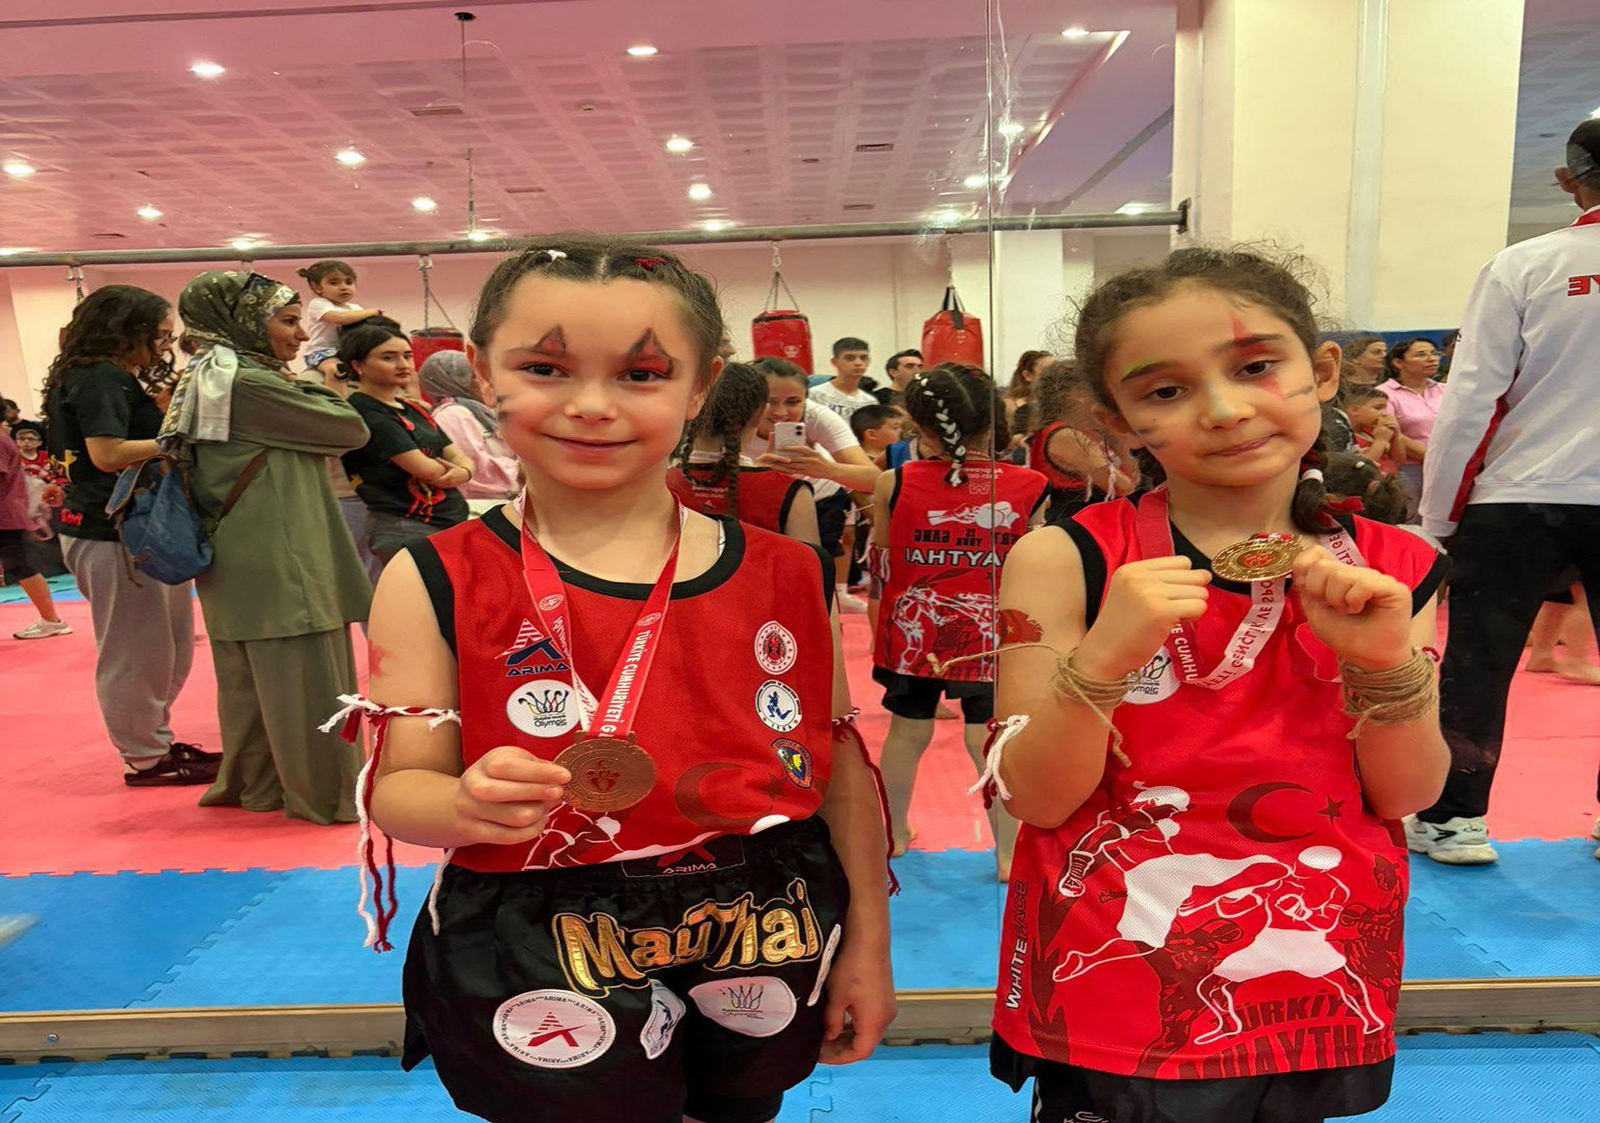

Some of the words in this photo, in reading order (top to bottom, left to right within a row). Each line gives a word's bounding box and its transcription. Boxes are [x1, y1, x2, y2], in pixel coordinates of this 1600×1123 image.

[626, 629, 652, 664] TÜRKİYE
[506, 662, 572, 677] ARIMA
[1174, 637, 1199, 682] CUMHU
[608, 663, 638, 725] CUMHURİYETİ
[662, 862, 718, 874] ARIMA
[1004, 879, 1028, 1010] WHITEFACE
[543, 994, 567, 1003] ARIMA
[574, 1002, 598, 1015] ARIMA
